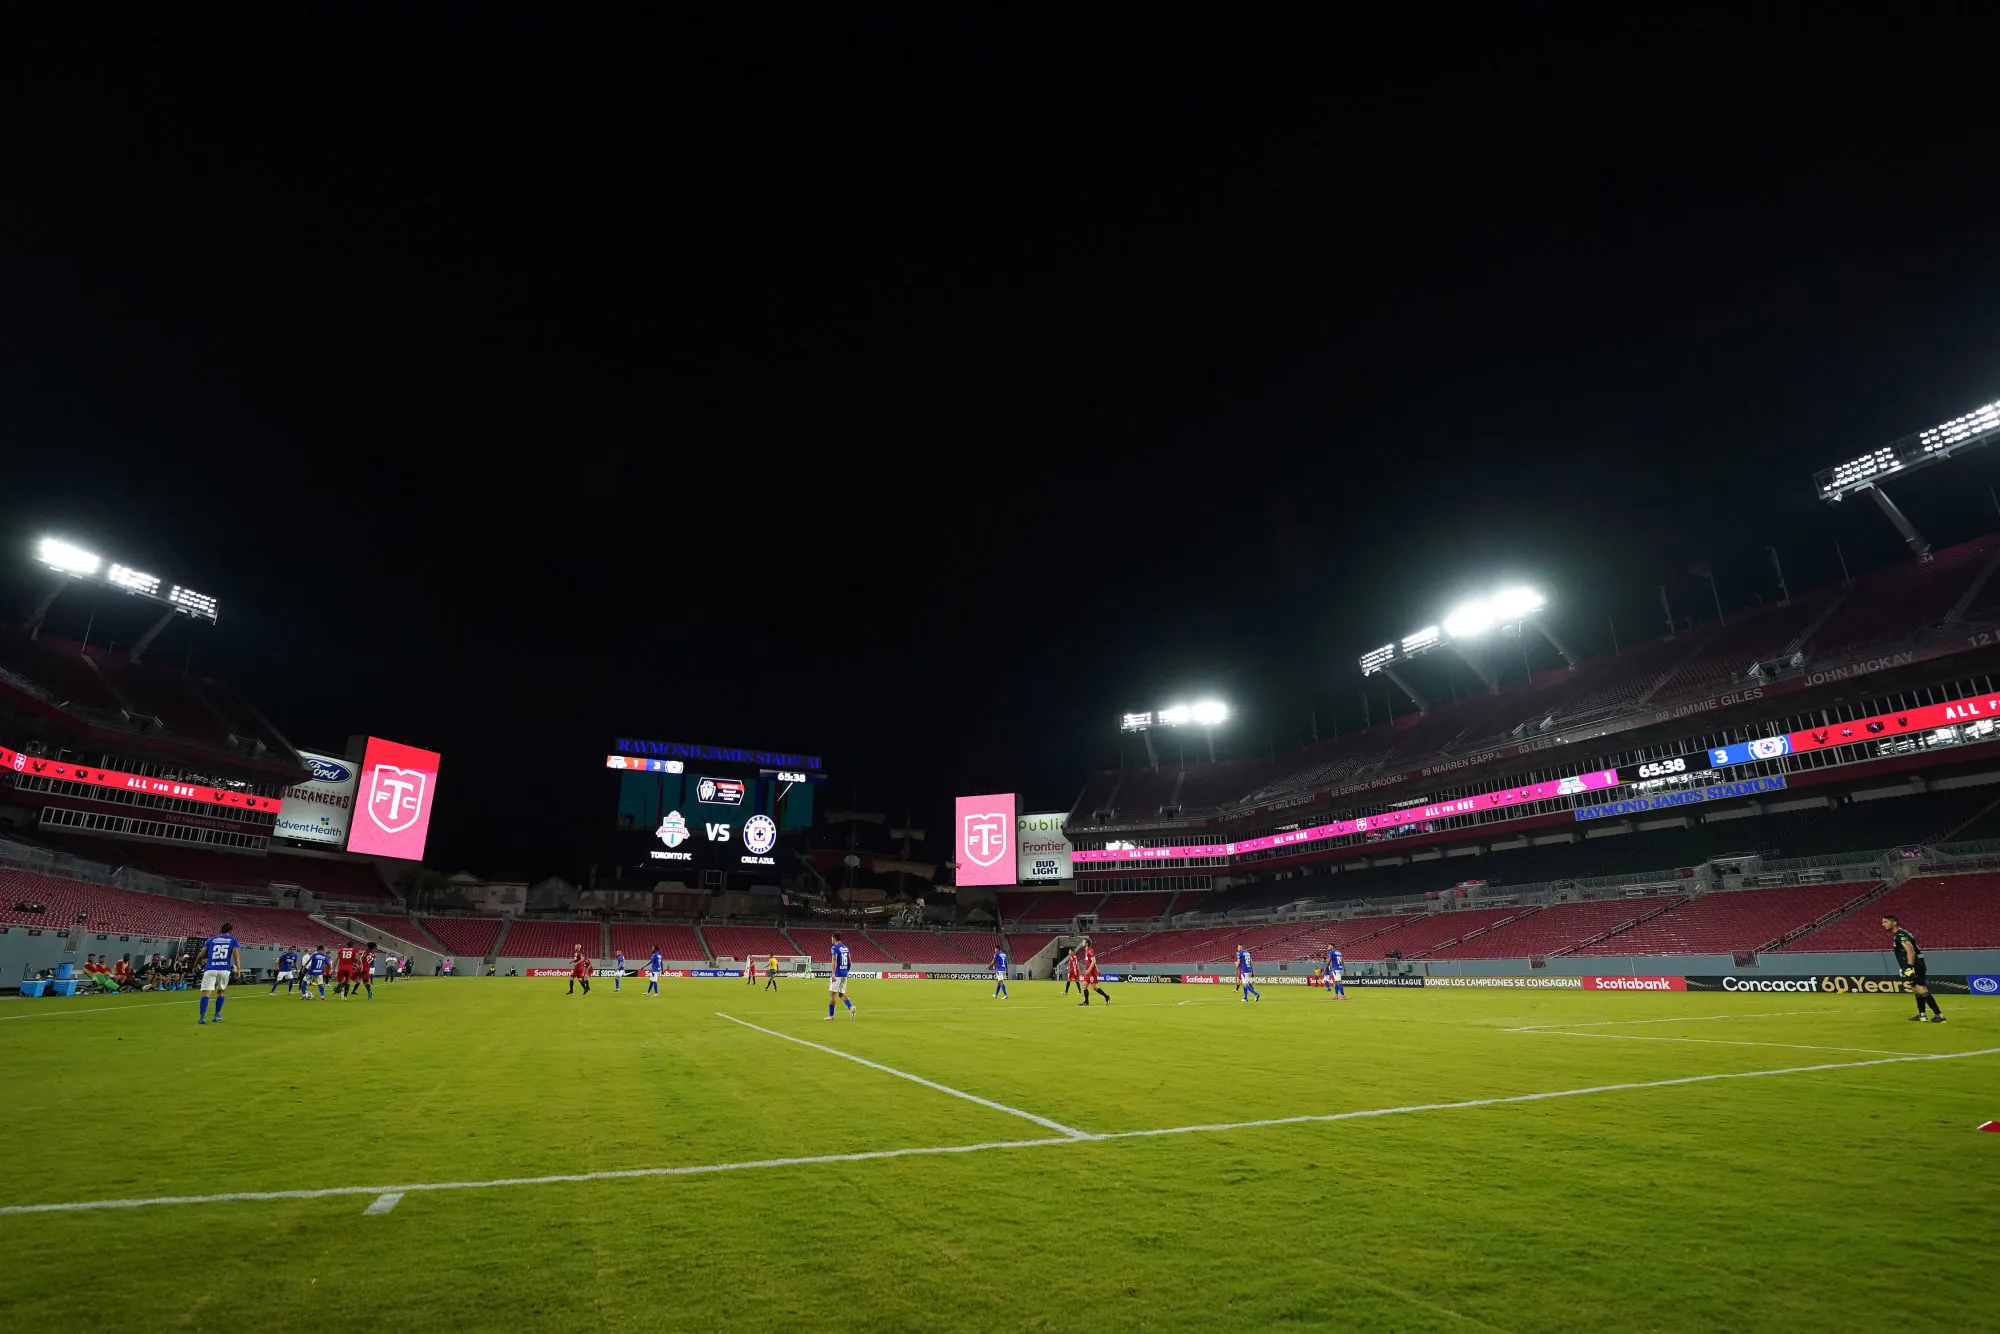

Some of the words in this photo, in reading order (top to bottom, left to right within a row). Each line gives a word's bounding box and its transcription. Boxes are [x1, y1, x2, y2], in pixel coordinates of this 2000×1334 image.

[1803, 666, 1848, 688] JOHN
[1852, 651, 1915, 675] MCKAY
[1656, 711, 1669, 721] 88
[1673, 698, 1718, 719] JIMMIE
[1721, 688, 1764, 707] GILES
[1945, 703, 1980, 719] ALL
[619, 738, 700, 757] RAYMOND
[702, 744, 754, 762] JAMES
[757, 751, 821, 769] STADIUM
[1714, 749, 1729, 764] 3
[308, 759, 339, 780] Ford
[634, 759, 639, 768] 1
[653, 761, 661, 770] 3
[1421, 765, 1432, 777] 99
[1432, 758, 1469, 775] WARREN
[1470, 752, 1495, 767] SAPP
[1639, 758, 1686, 778] 65:38
[778, 773, 806, 783] 65:38
[1603, 771, 1612, 784] 1
[127, 777, 147, 789] ALL
[153, 783, 169, 792] FOR
[174, 785, 195, 797] ONE
[1340, 781, 1370, 795] DERRICK
[1372, 775, 1402, 789] BROOKS
[1575, 799, 1649, 820] RAYMOND
[1651, 787, 1703, 808] JAMES
[1708, 776, 1784, 801] STADIUM
[1425, 806, 1440, 817] ALL
[275, 818, 342, 837] AdventHealth
[705, 822, 730, 841] VS
[1022, 841, 1066, 852] Frontier
[650, 851, 682, 860] TORONTO
[741, 856, 758, 864] CRUZ
[758, 857, 775, 865] AZUL
[1033, 867, 1059, 875] LIGHT
[212, 944, 230, 960] 25
[342, 950, 353, 959] 18
[841, 953, 848, 966] 16
[1128, 974, 1149, 983] Concacaf
[1186, 975, 1213, 983] Scotiabank
[1219, 976, 1236, 984] WHERE
[1267, 976, 1278, 984] ARE
[1279, 976, 1307, 984] CROWNED
[1425, 979, 1450, 987] DONDE
[1451, 979, 1466, 987] LOS
[1466, 979, 1514, 987] CAMPEONES
[1515, 979, 1525, 987] SE
[1526, 979, 1581, 988] CONSAGRAN
[1596, 978, 1671, 990] Scotiabank
[1722, 976, 1817, 992] Concacaf
[1821, 976, 1848, 992] 60
[1849, 976, 1915, 993] Years
